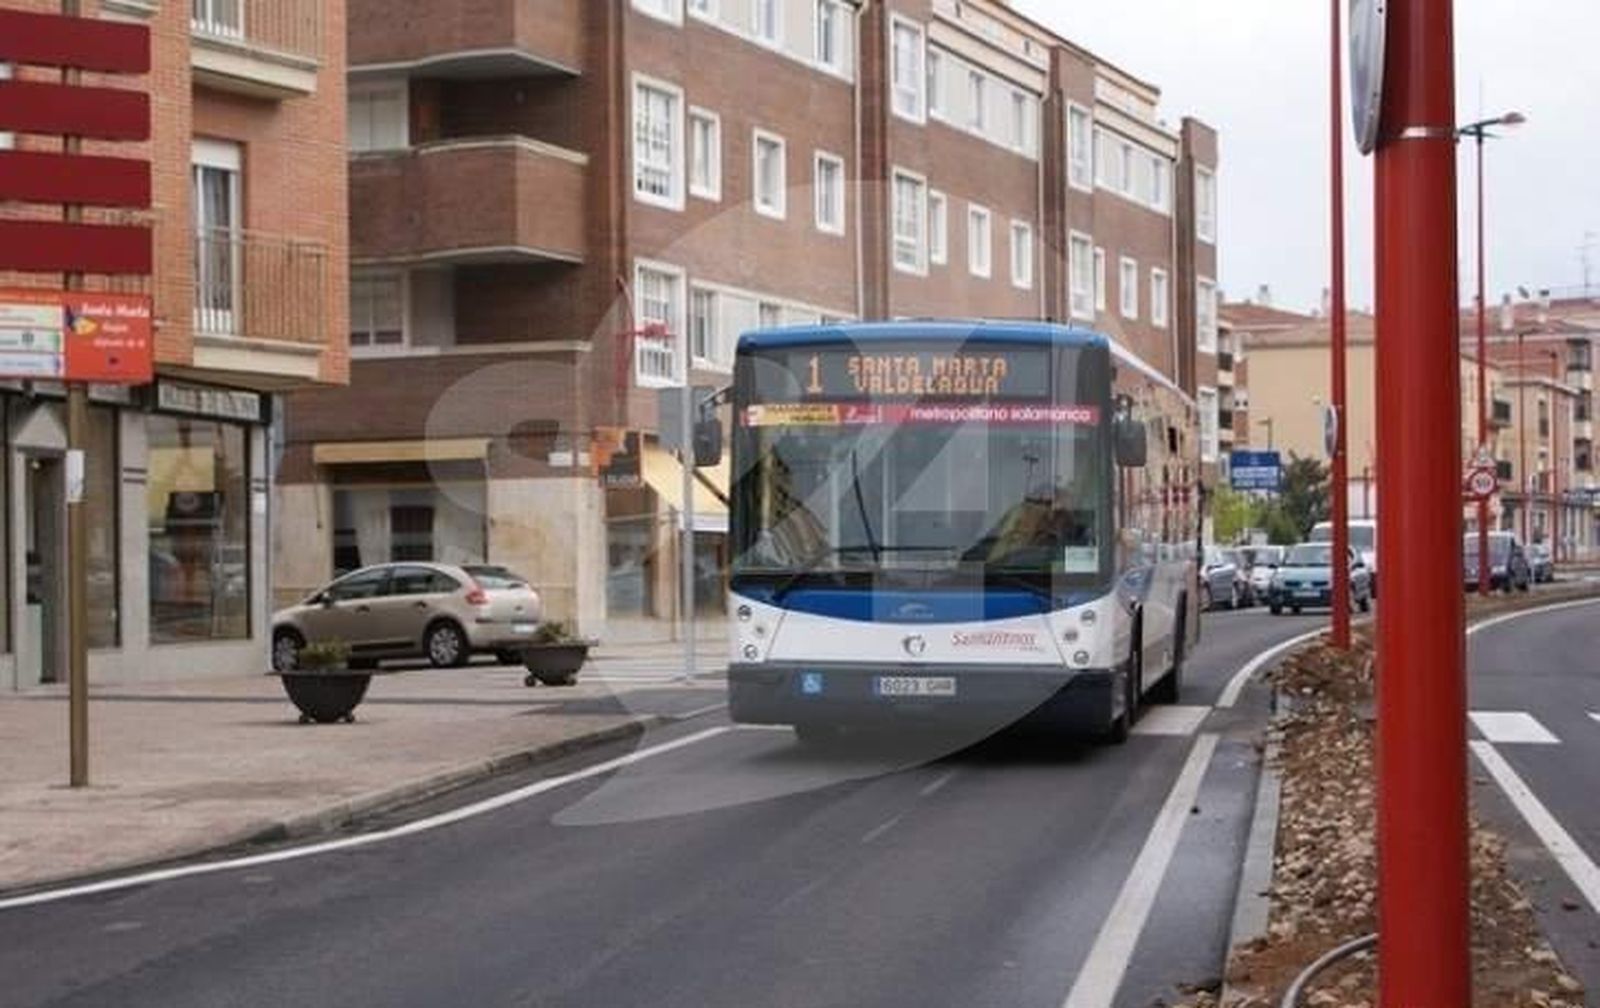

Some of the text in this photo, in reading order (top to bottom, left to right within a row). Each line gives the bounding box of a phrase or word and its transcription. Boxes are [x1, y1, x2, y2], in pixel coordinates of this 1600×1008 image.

[806, 355, 1008, 393] 1 SANTA MARTA
[910, 405, 1092, 423] metropolitano salamanca
